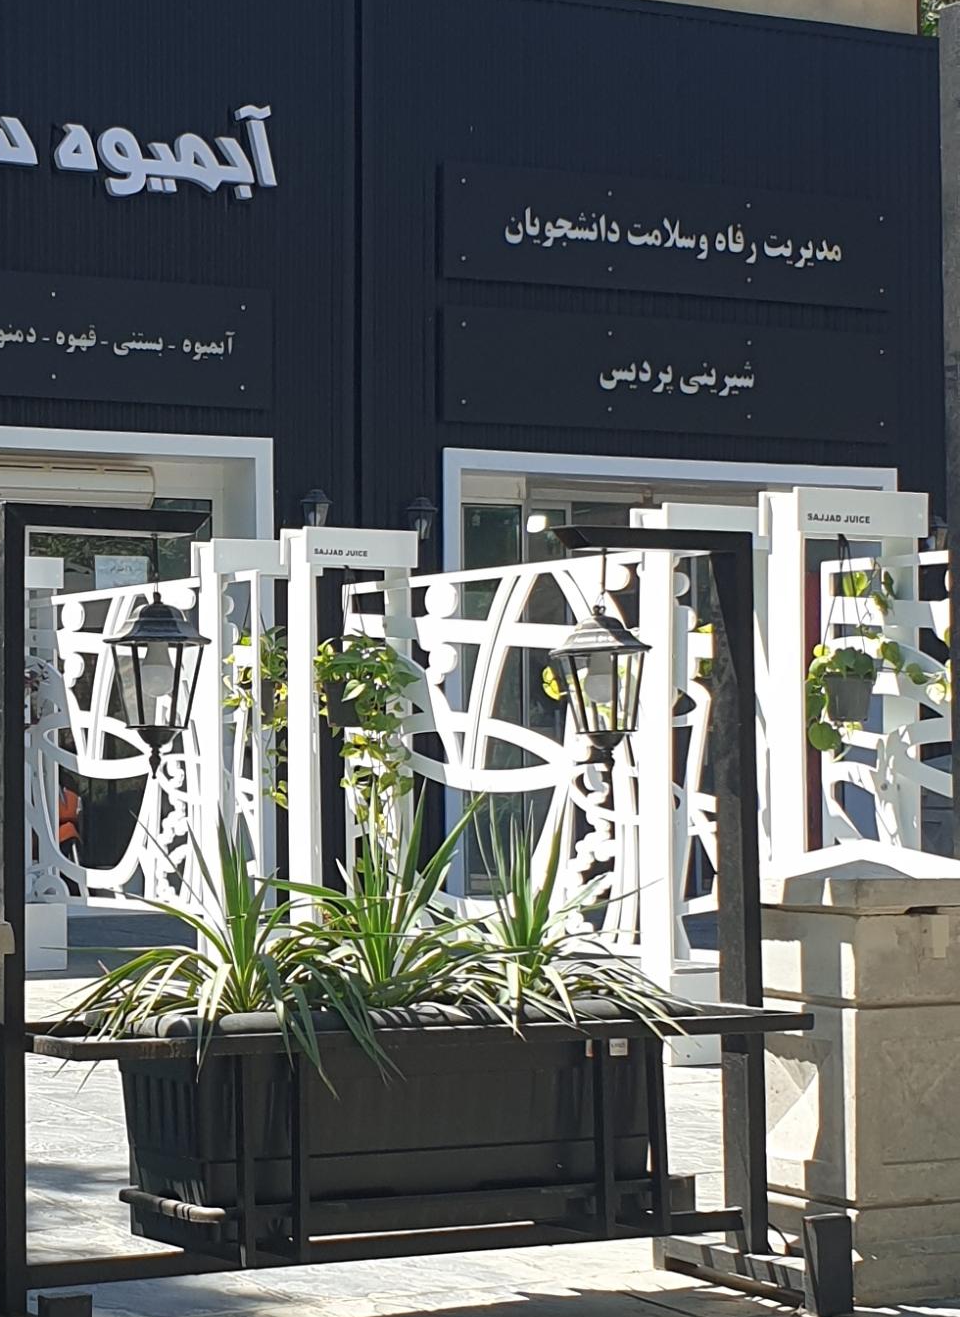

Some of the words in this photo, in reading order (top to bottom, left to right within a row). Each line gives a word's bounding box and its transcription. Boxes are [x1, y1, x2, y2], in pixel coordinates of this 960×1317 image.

[52, 103, 279, 201] آبمیوه
[504, 206, 621, 247] دانشجویان
[714, 222, 758, 264] رفاه
[762, 234, 843, 269] مدیریت
[55, 325, 97, 353] قهوه
[113, 332, 164, 357] بستنی
[182, 331, 235, 361] آبمیوه
[598, 359, 675, 395] پردیس
[679, 360, 756, 397] شیرینی
[806, 512, 842, 523] SAJJAD
[843, 514, 871, 525] JUICE
[313, 547, 344, 557] SAJJAD
[345, 549, 369, 558] JUICE
